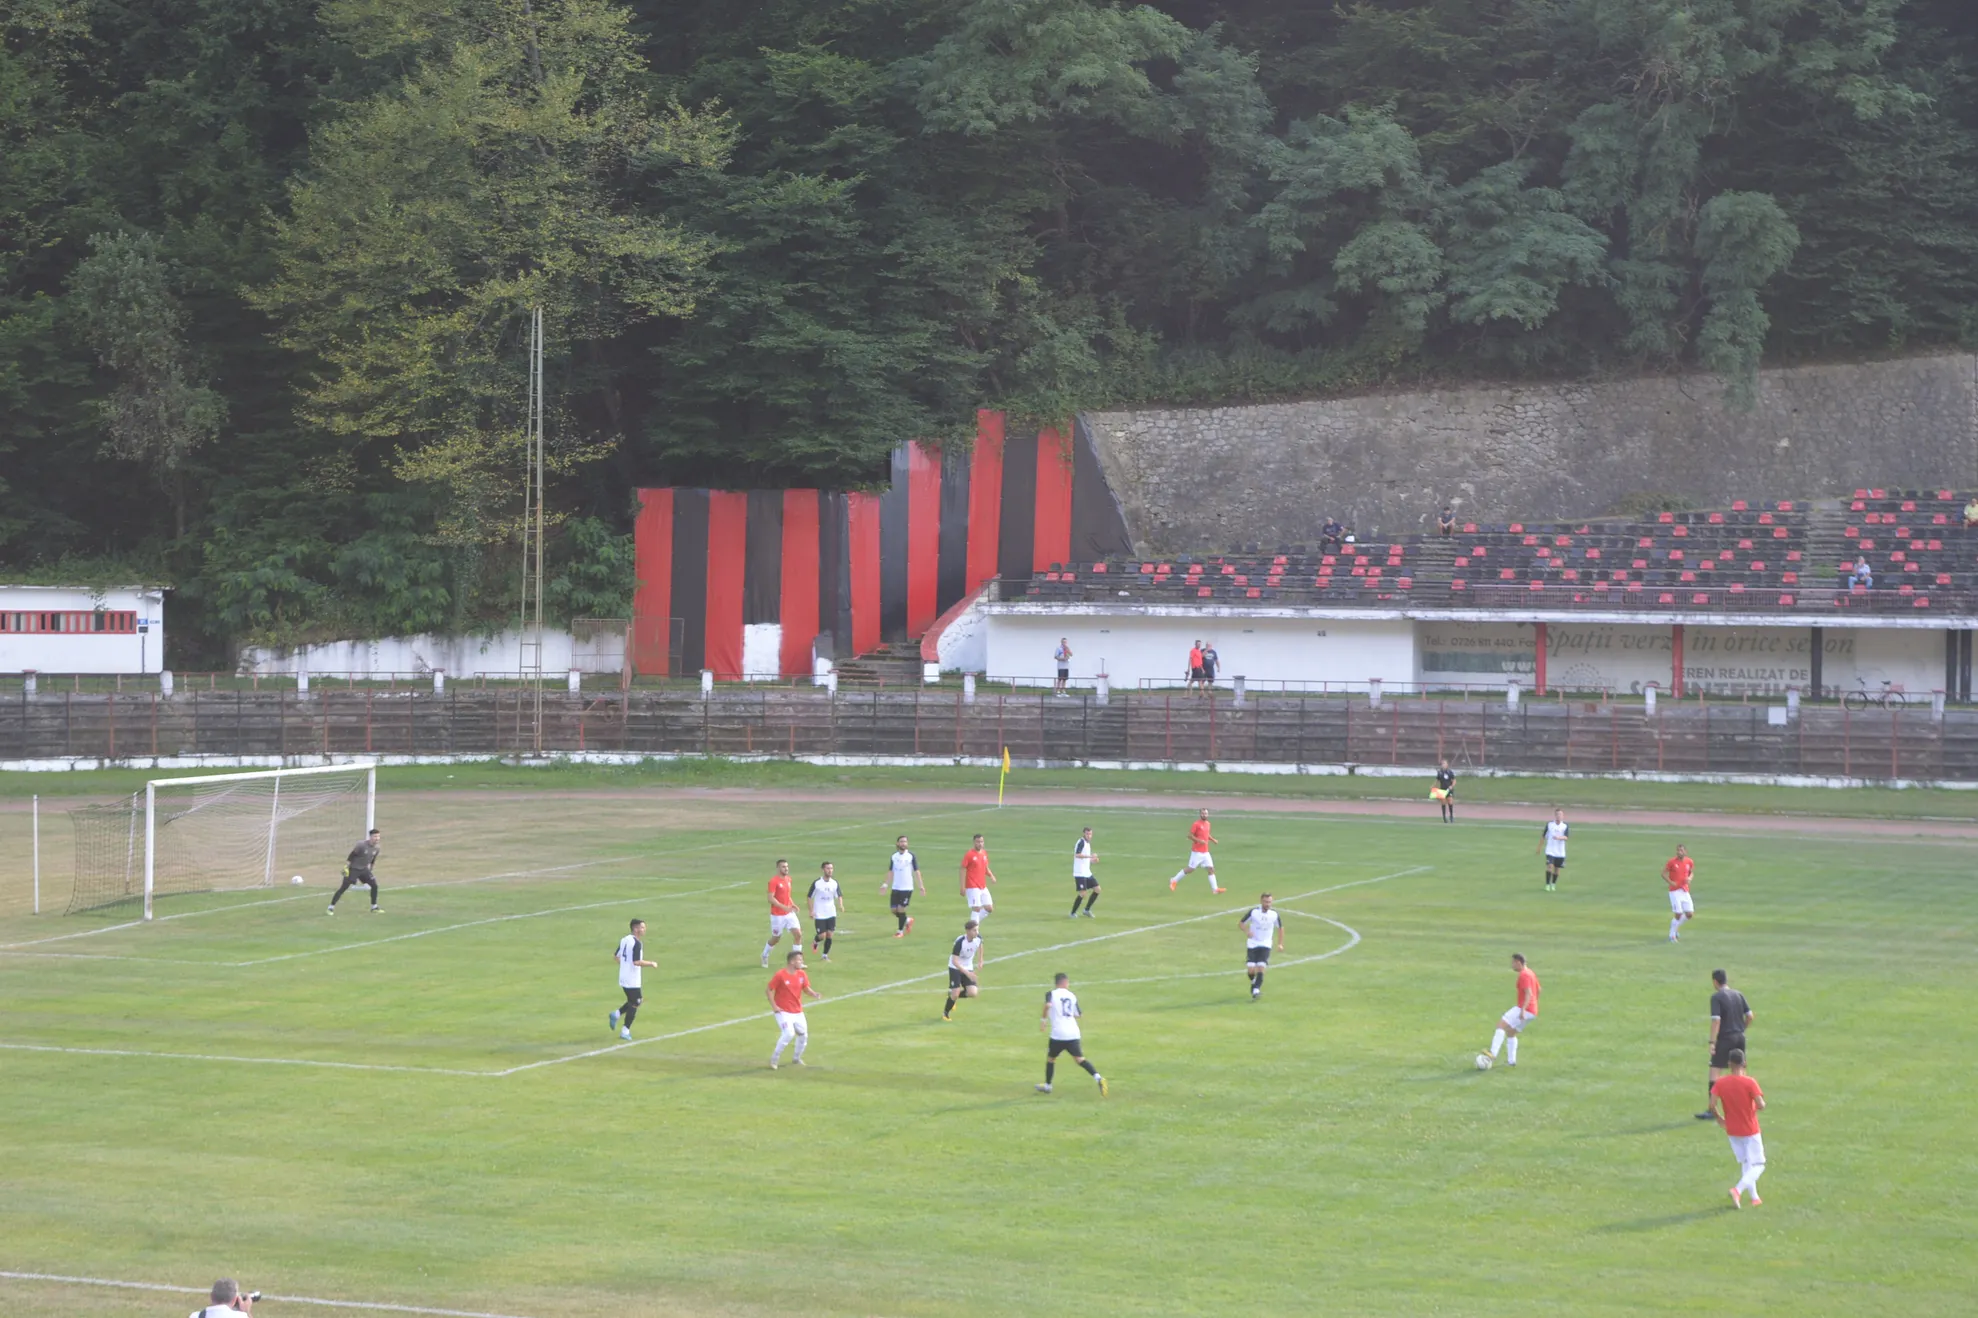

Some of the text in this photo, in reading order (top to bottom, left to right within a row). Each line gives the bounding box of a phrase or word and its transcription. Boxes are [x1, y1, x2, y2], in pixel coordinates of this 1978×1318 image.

[1451, 637, 1476, 647] 0726
[1620, 633, 1673, 650] verz
[1692, 628, 1716, 651] în
[1724, 629, 1782, 652] orice
[1786, 634, 1854, 653] seon
[1501, 661, 1536, 672] ww
[1719, 667, 1786, 681] REALIZAT
[1789, 669, 1808, 681] DE
[622, 944, 627, 961] 4
